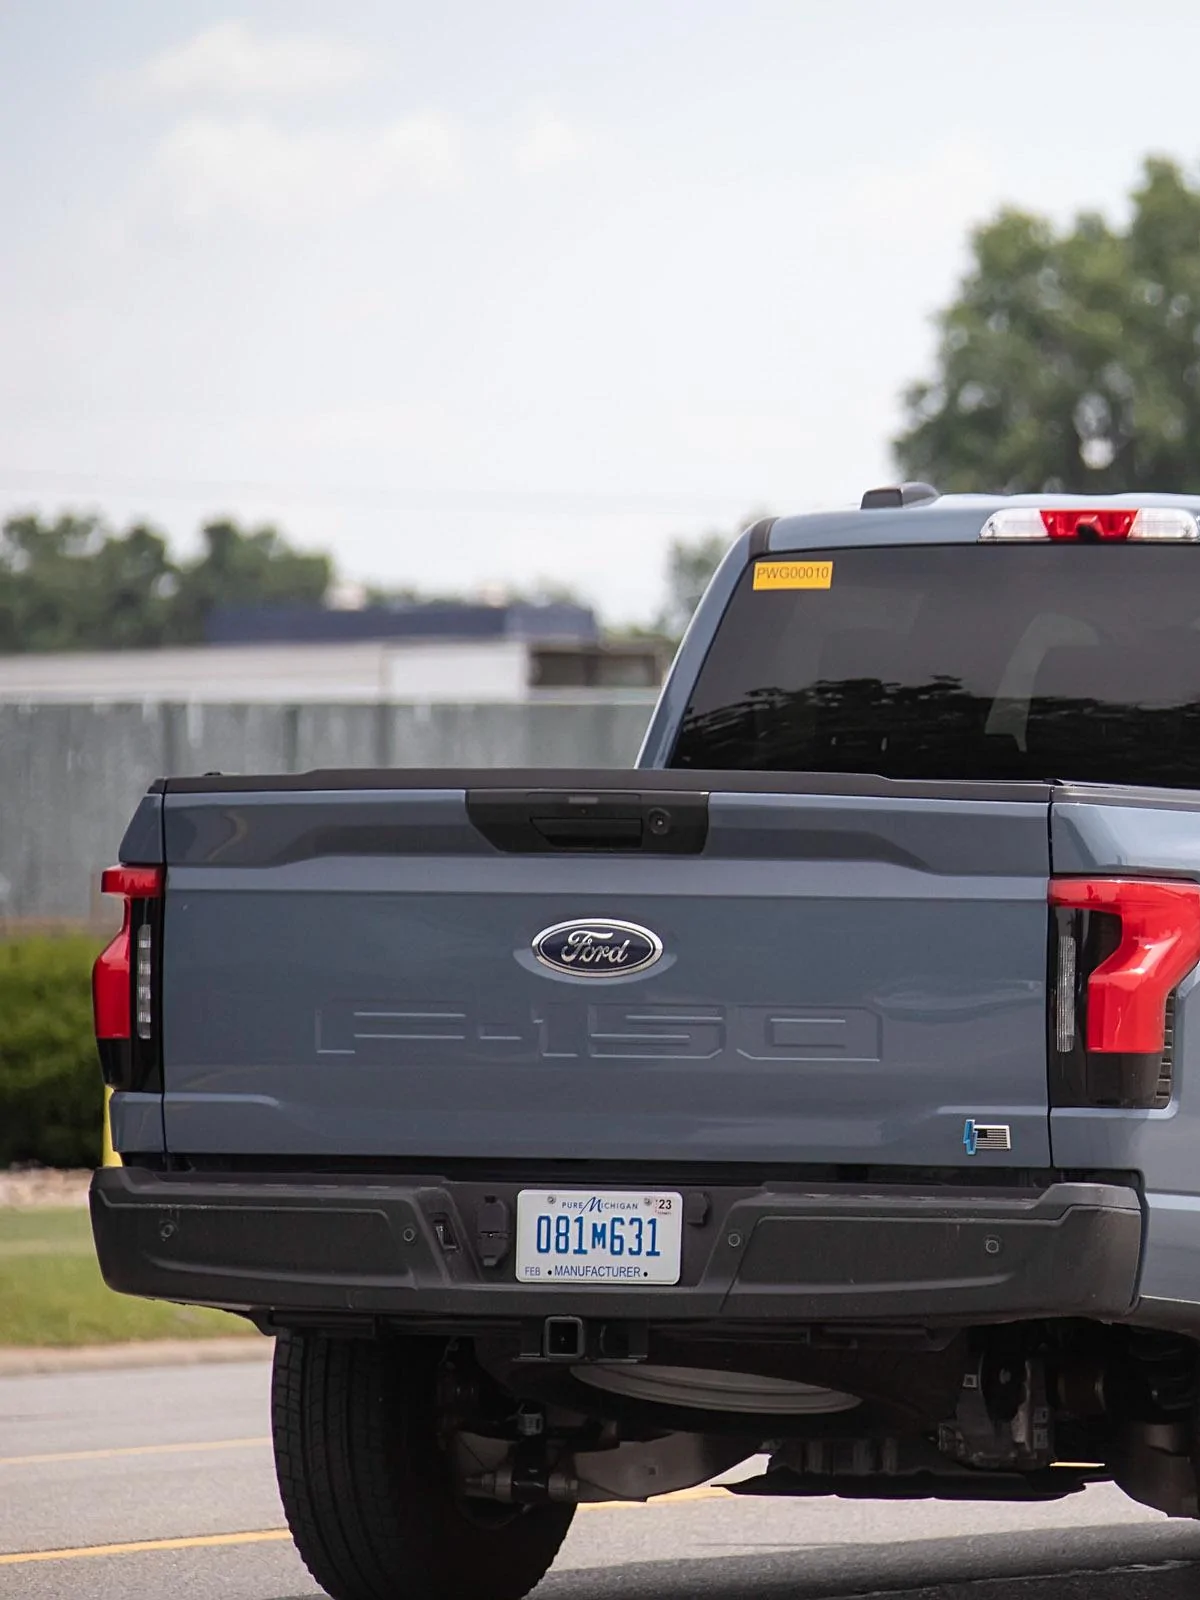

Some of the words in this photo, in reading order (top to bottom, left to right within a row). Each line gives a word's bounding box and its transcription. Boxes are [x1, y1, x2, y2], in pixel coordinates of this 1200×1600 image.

[756, 566, 829, 579] PWG00010
[560, 930, 628, 964] Ford
[315, 1002, 882, 1062] F-150
[562, 1201, 583, 1209] PURE
[580, 1196, 638, 1214] MICHIGAN
[536, 1215, 661, 1257] 081M631
[525, 1267, 541, 1276] FEB
[554, 1265, 641, 1278] MANUFACTURER
